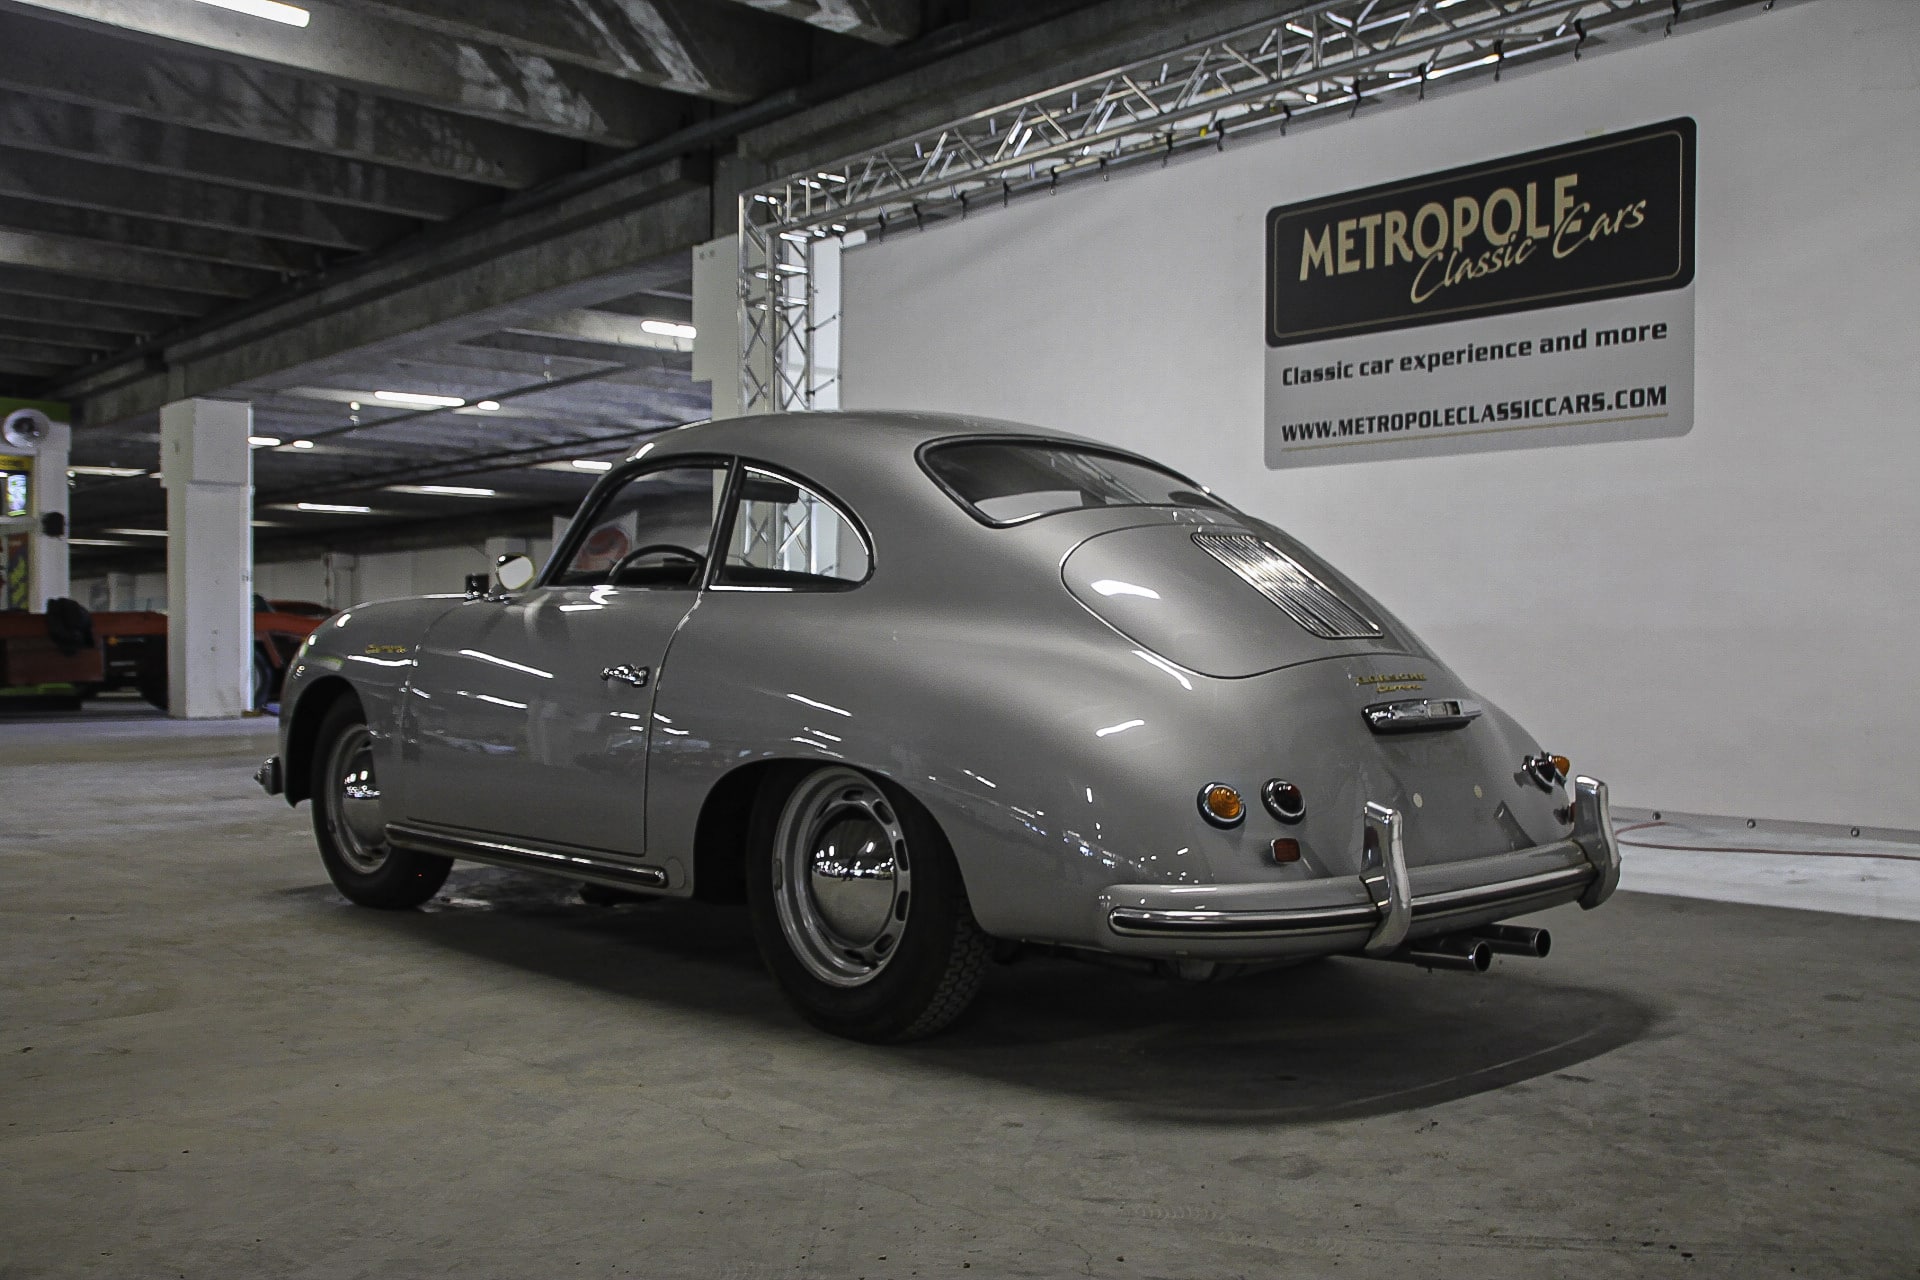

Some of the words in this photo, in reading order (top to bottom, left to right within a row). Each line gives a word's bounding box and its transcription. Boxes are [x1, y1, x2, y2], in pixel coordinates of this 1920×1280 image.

[1300, 173, 1582, 281] METROPOLE
[1410, 233, 1537, 304] Classic
[1552, 200, 1647, 259] Cars
[1282, 361, 1353, 386] Classic
[1359, 358, 1394, 376] car
[1399, 340, 1532, 373] experience
[1539, 328, 1587, 354] and
[1595, 322, 1668, 348] more
[1281, 385, 1667, 442] WWW.METROPOLECLASSICCARS.COM
